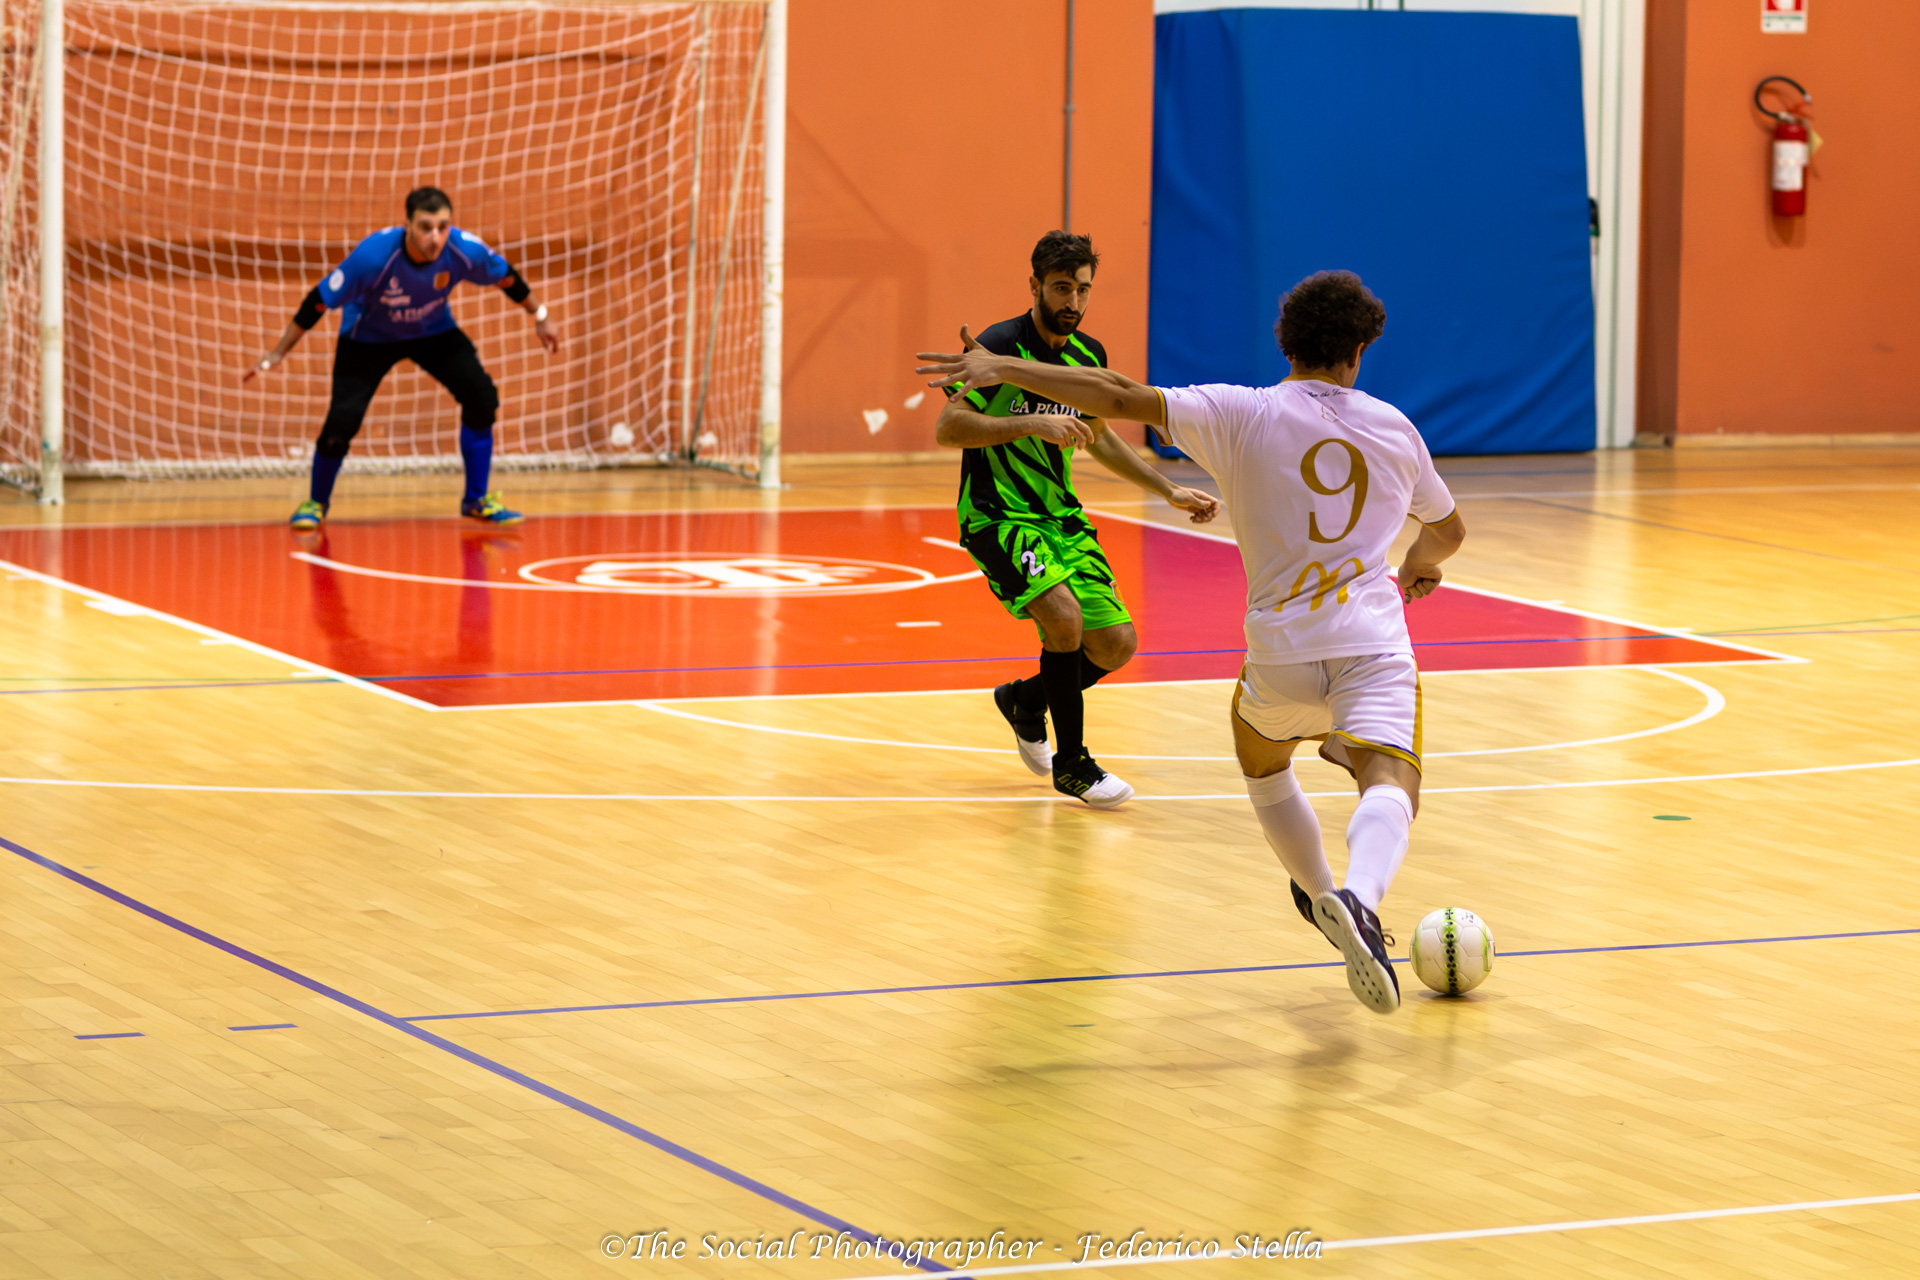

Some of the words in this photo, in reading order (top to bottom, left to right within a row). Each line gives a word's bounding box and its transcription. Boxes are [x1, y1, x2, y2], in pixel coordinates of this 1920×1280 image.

[1009, 400, 1029, 413] LA
[1301, 438, 1368, 543] 9
[1021, 550, 1046, 576] 2
